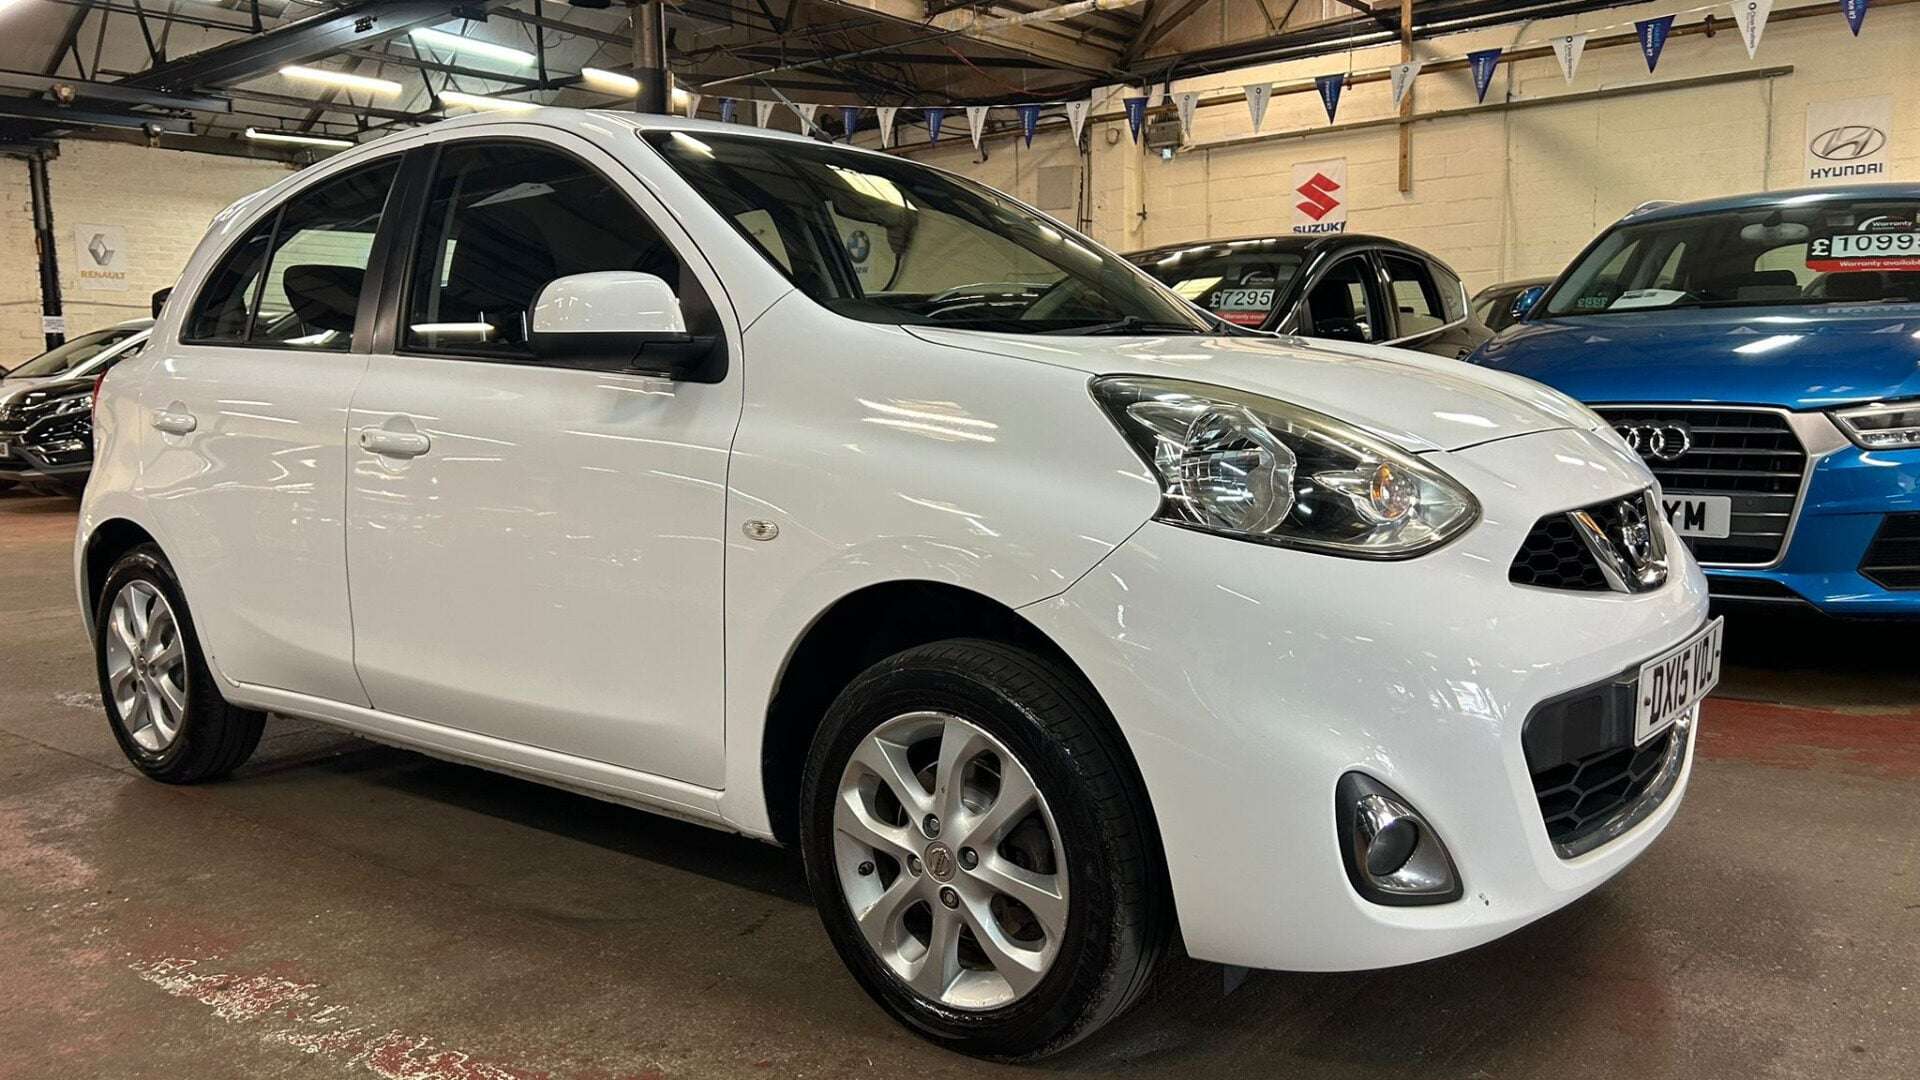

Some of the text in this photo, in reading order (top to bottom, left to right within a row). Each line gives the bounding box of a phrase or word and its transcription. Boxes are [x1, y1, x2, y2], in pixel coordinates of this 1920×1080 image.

[1810, 162, 1883, 179] HYUNDAI
[1292, 220, 1347, 234] SUZUKI
[1871, 220, 1913, 228] Warranty
[1811, 234, 1920, 256] £1099
[1840, 259, 1881, 268] Warranty
[80, 270, 126, 280] RENAULT
[1209, 290, 1272, 308] £7295
[1649, 649, 1691, 726] DX15
